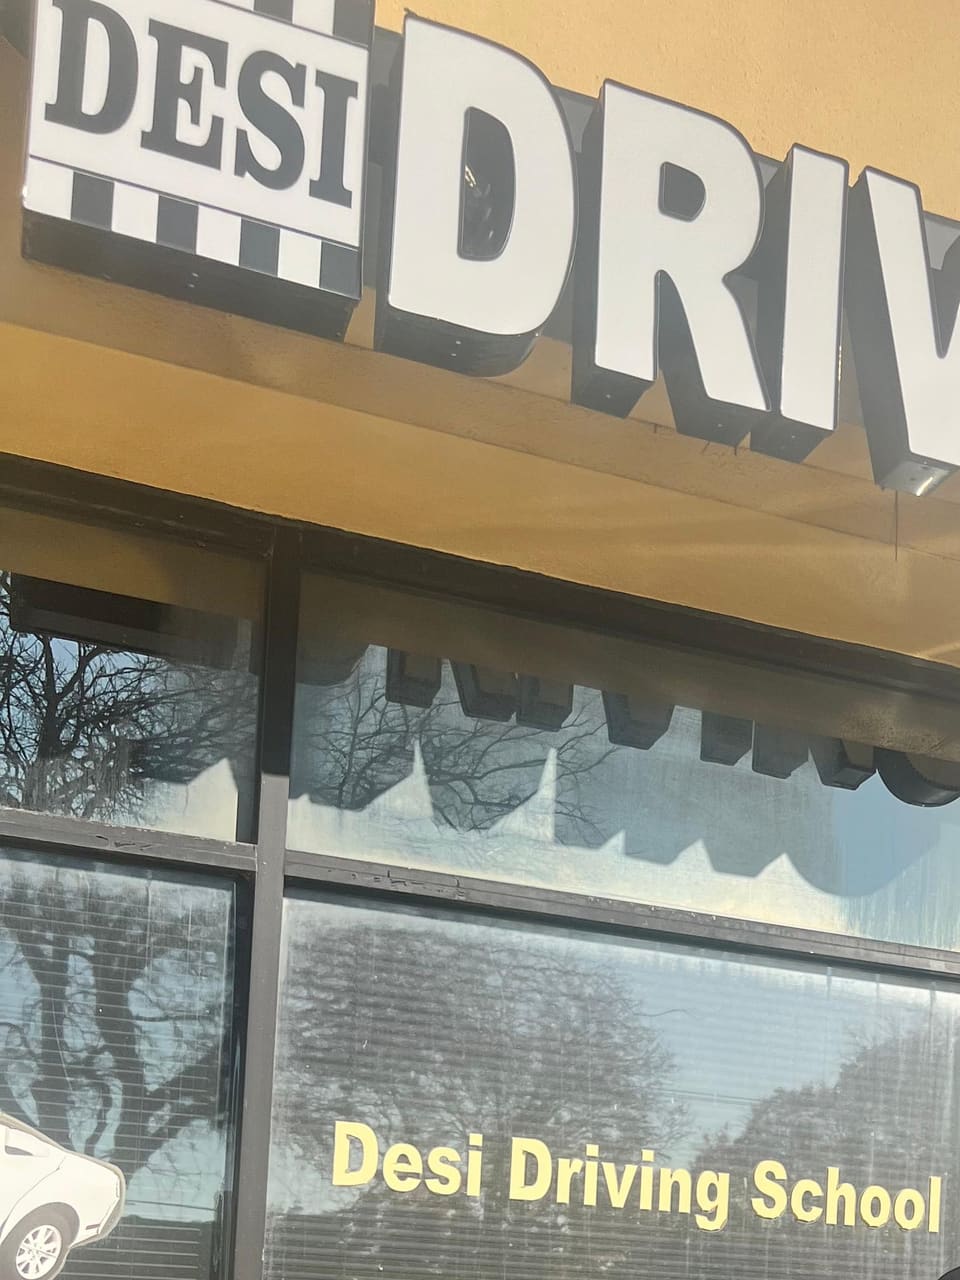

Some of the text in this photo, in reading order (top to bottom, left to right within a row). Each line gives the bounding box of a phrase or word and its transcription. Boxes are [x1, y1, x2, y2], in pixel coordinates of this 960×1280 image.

[44, 0, 358, 208] DESI
[332, 1120, 942, 1233] Desi Driving School
